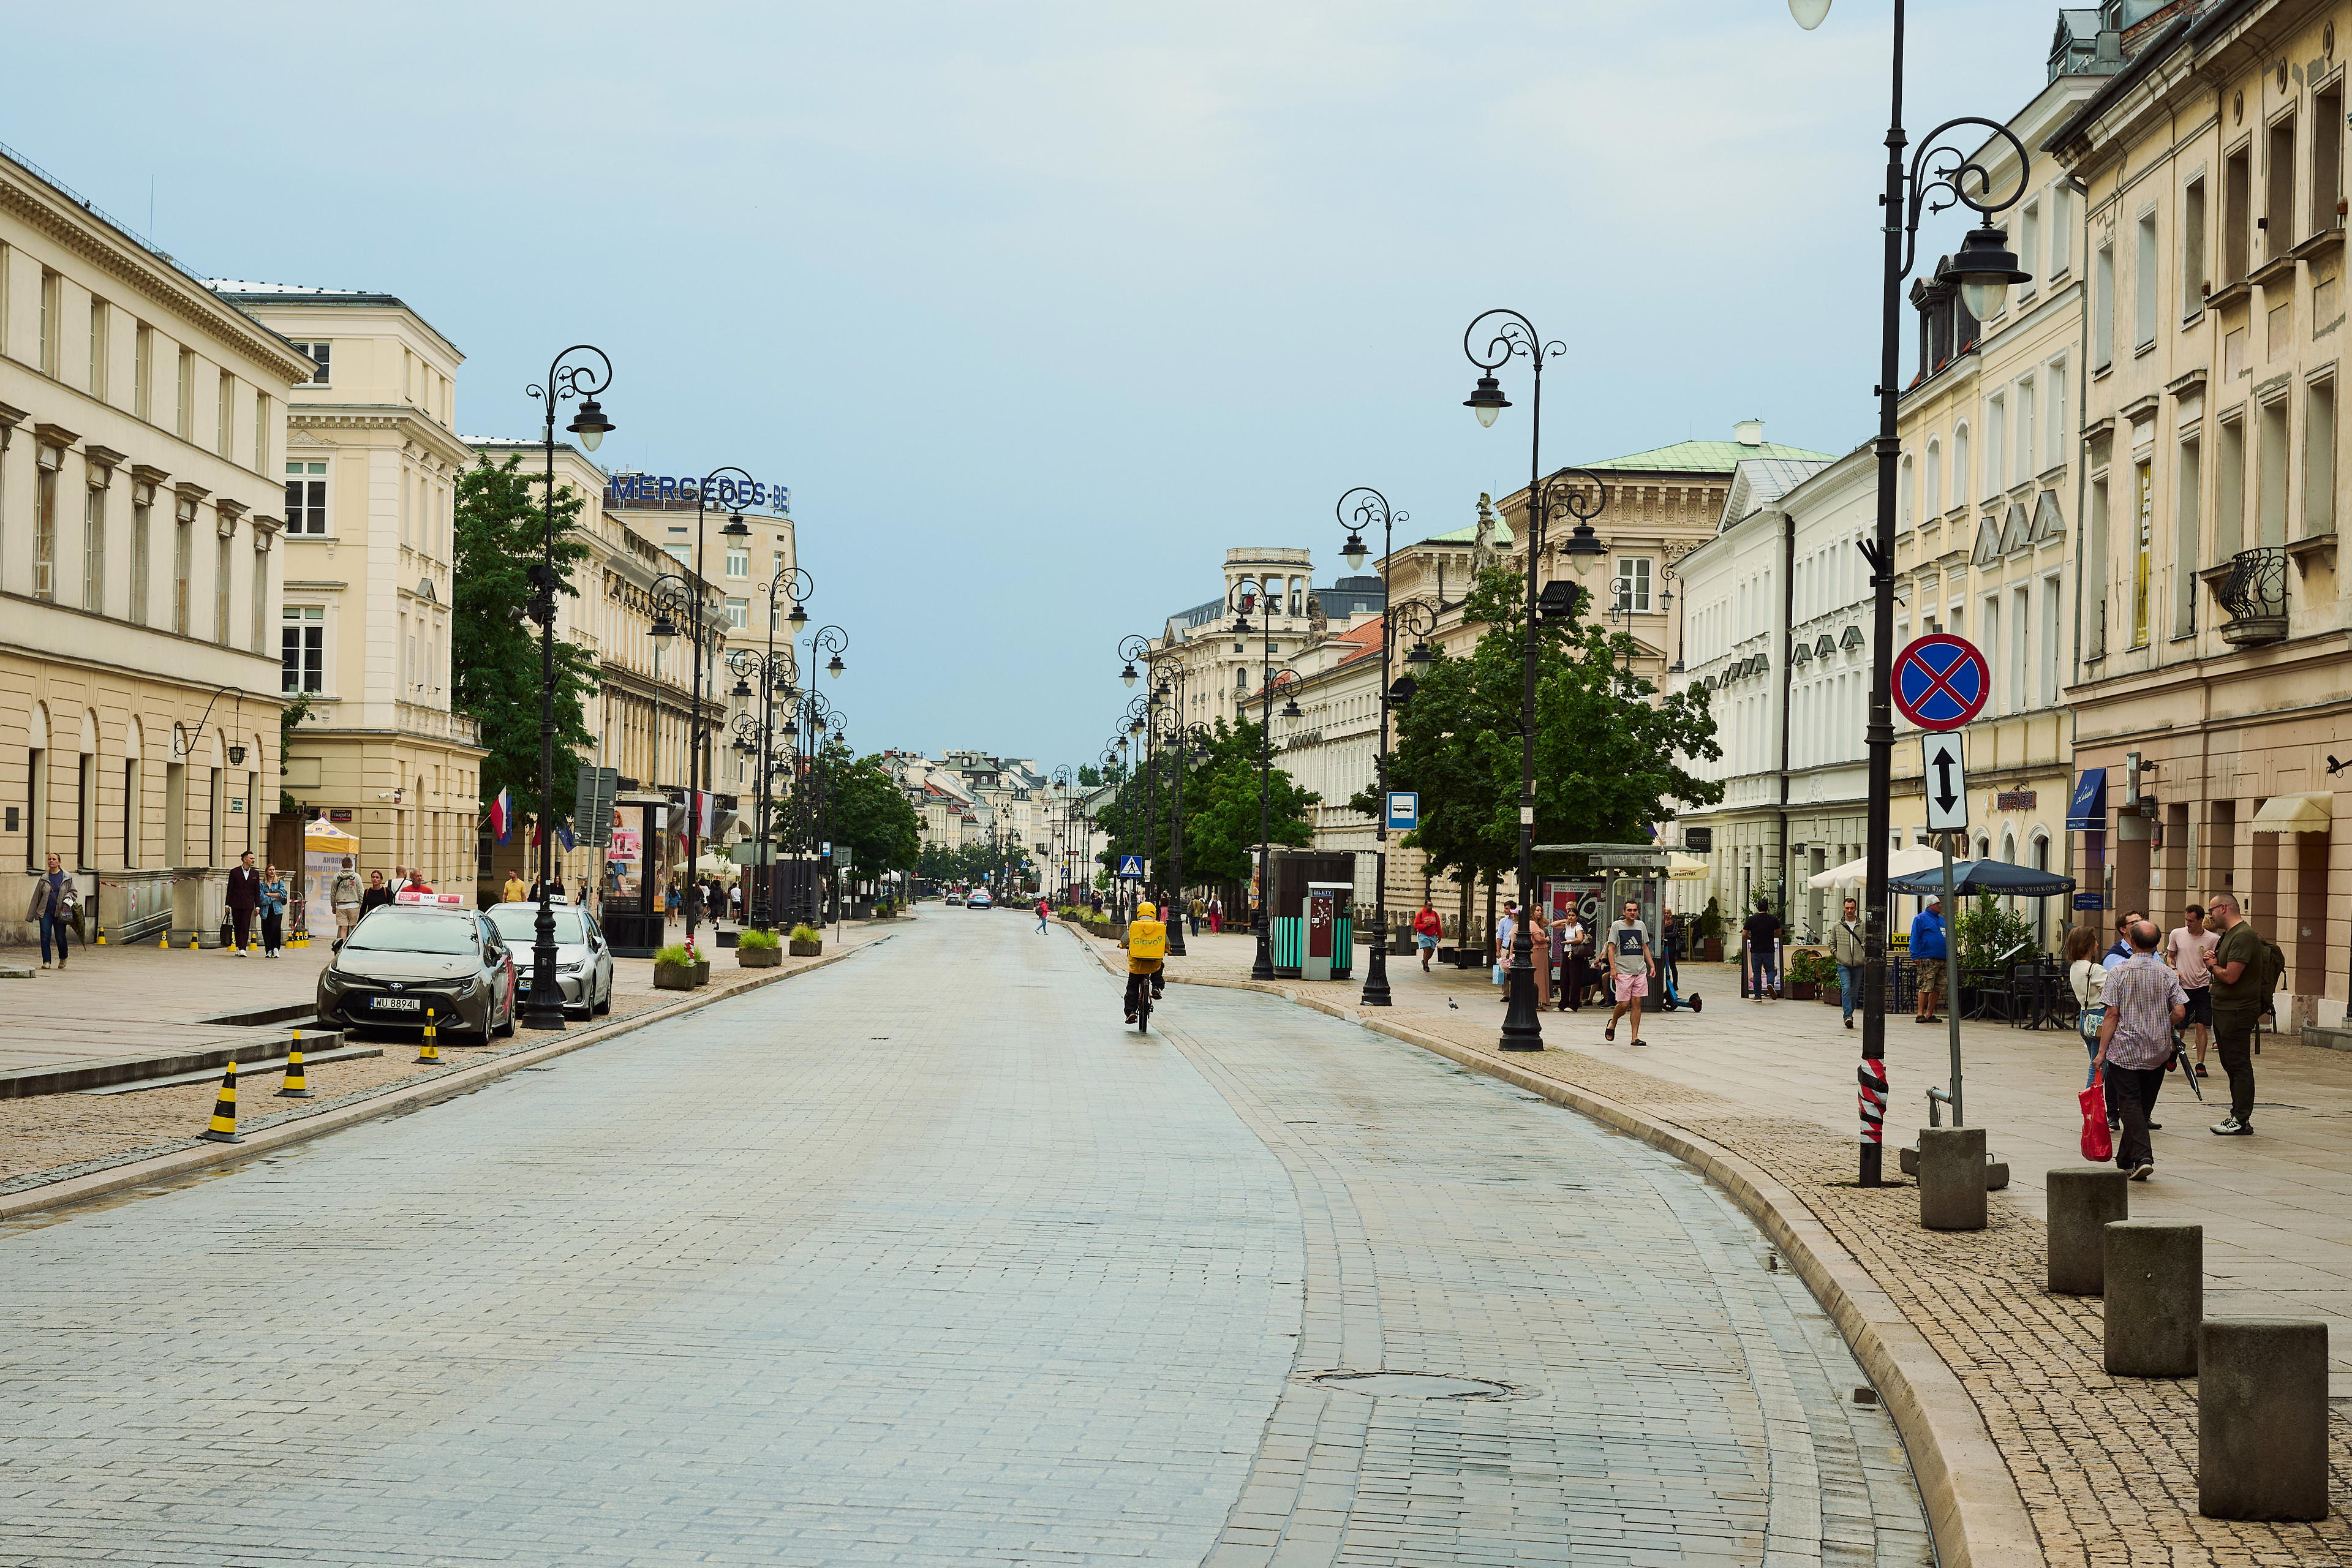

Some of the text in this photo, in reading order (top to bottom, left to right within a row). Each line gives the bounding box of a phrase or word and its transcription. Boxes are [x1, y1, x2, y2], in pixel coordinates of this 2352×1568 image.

[609, 838, 634, 854] ALE
[376, 998, 418, 1009] WU 8894L
